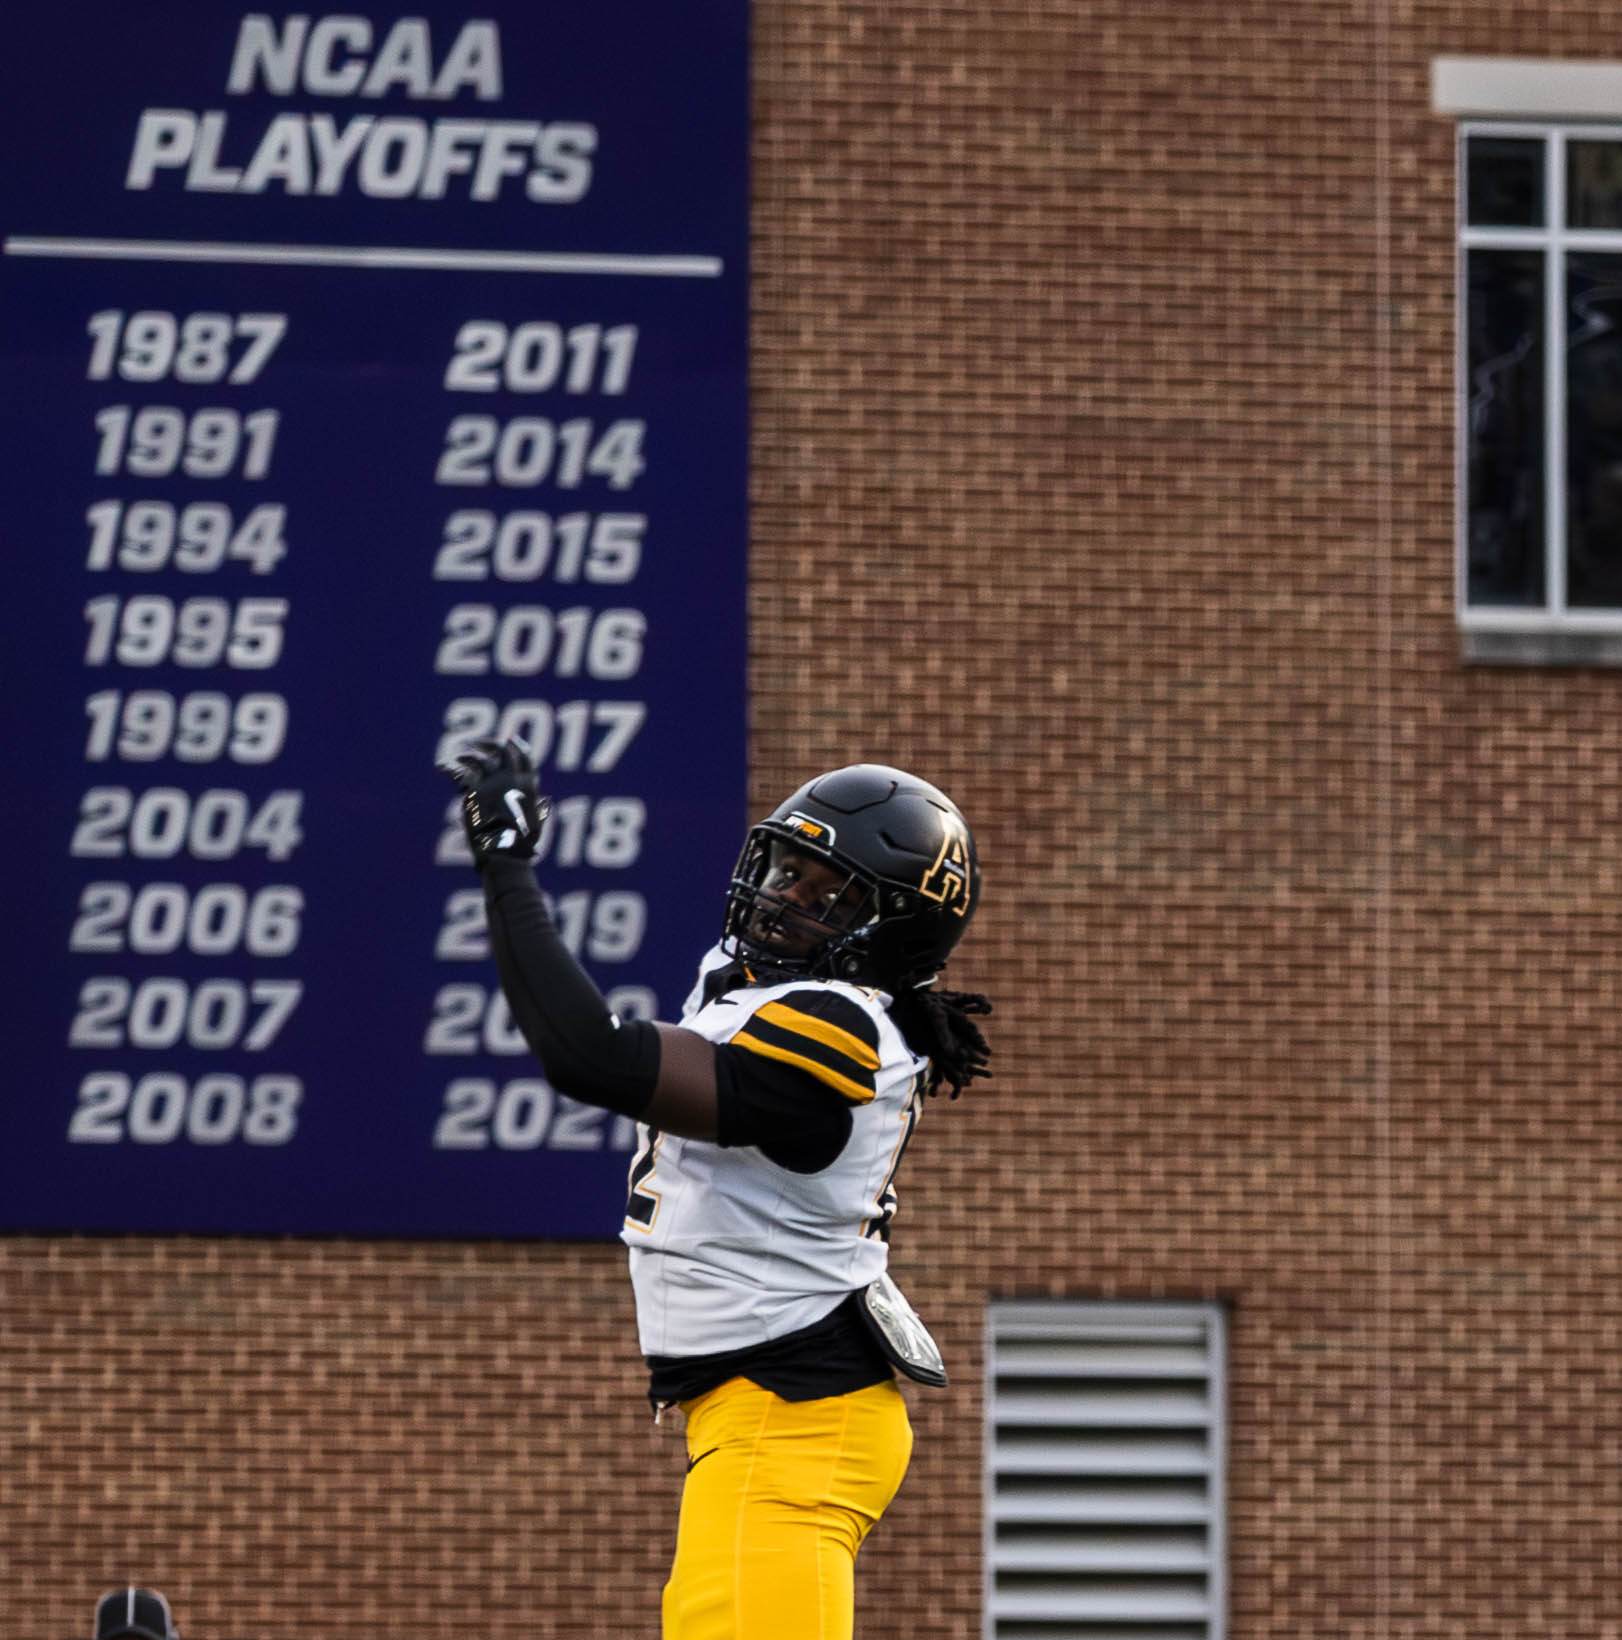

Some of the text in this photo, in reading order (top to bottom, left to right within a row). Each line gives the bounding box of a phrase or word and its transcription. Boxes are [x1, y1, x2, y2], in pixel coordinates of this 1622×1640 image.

[228, 14, 502, 100] NCAA
[126, 108, 597, 203] PLAYOFFS
[88, 311, 287, 384] 1987
[445, 322, 638, 394] 2011
[96, 406, 279, 479] 1991
[436, 416, 645, 488] 2014
[87, 500, 287, 574] 1994
[434, 510, 647, 583] 2015
[86, 596, 288, 668] 1995
[435, 605, 647, 679] 2016
[87, 691, 288, 763] 1999
[72, 788, 303, 859] 2004
[71, 883, 304, 956] 2006
[435, 889, 646, 960] 219
[70, 978, 303, 1050] 2007
[69, 1072, 303, 1144] 2008
